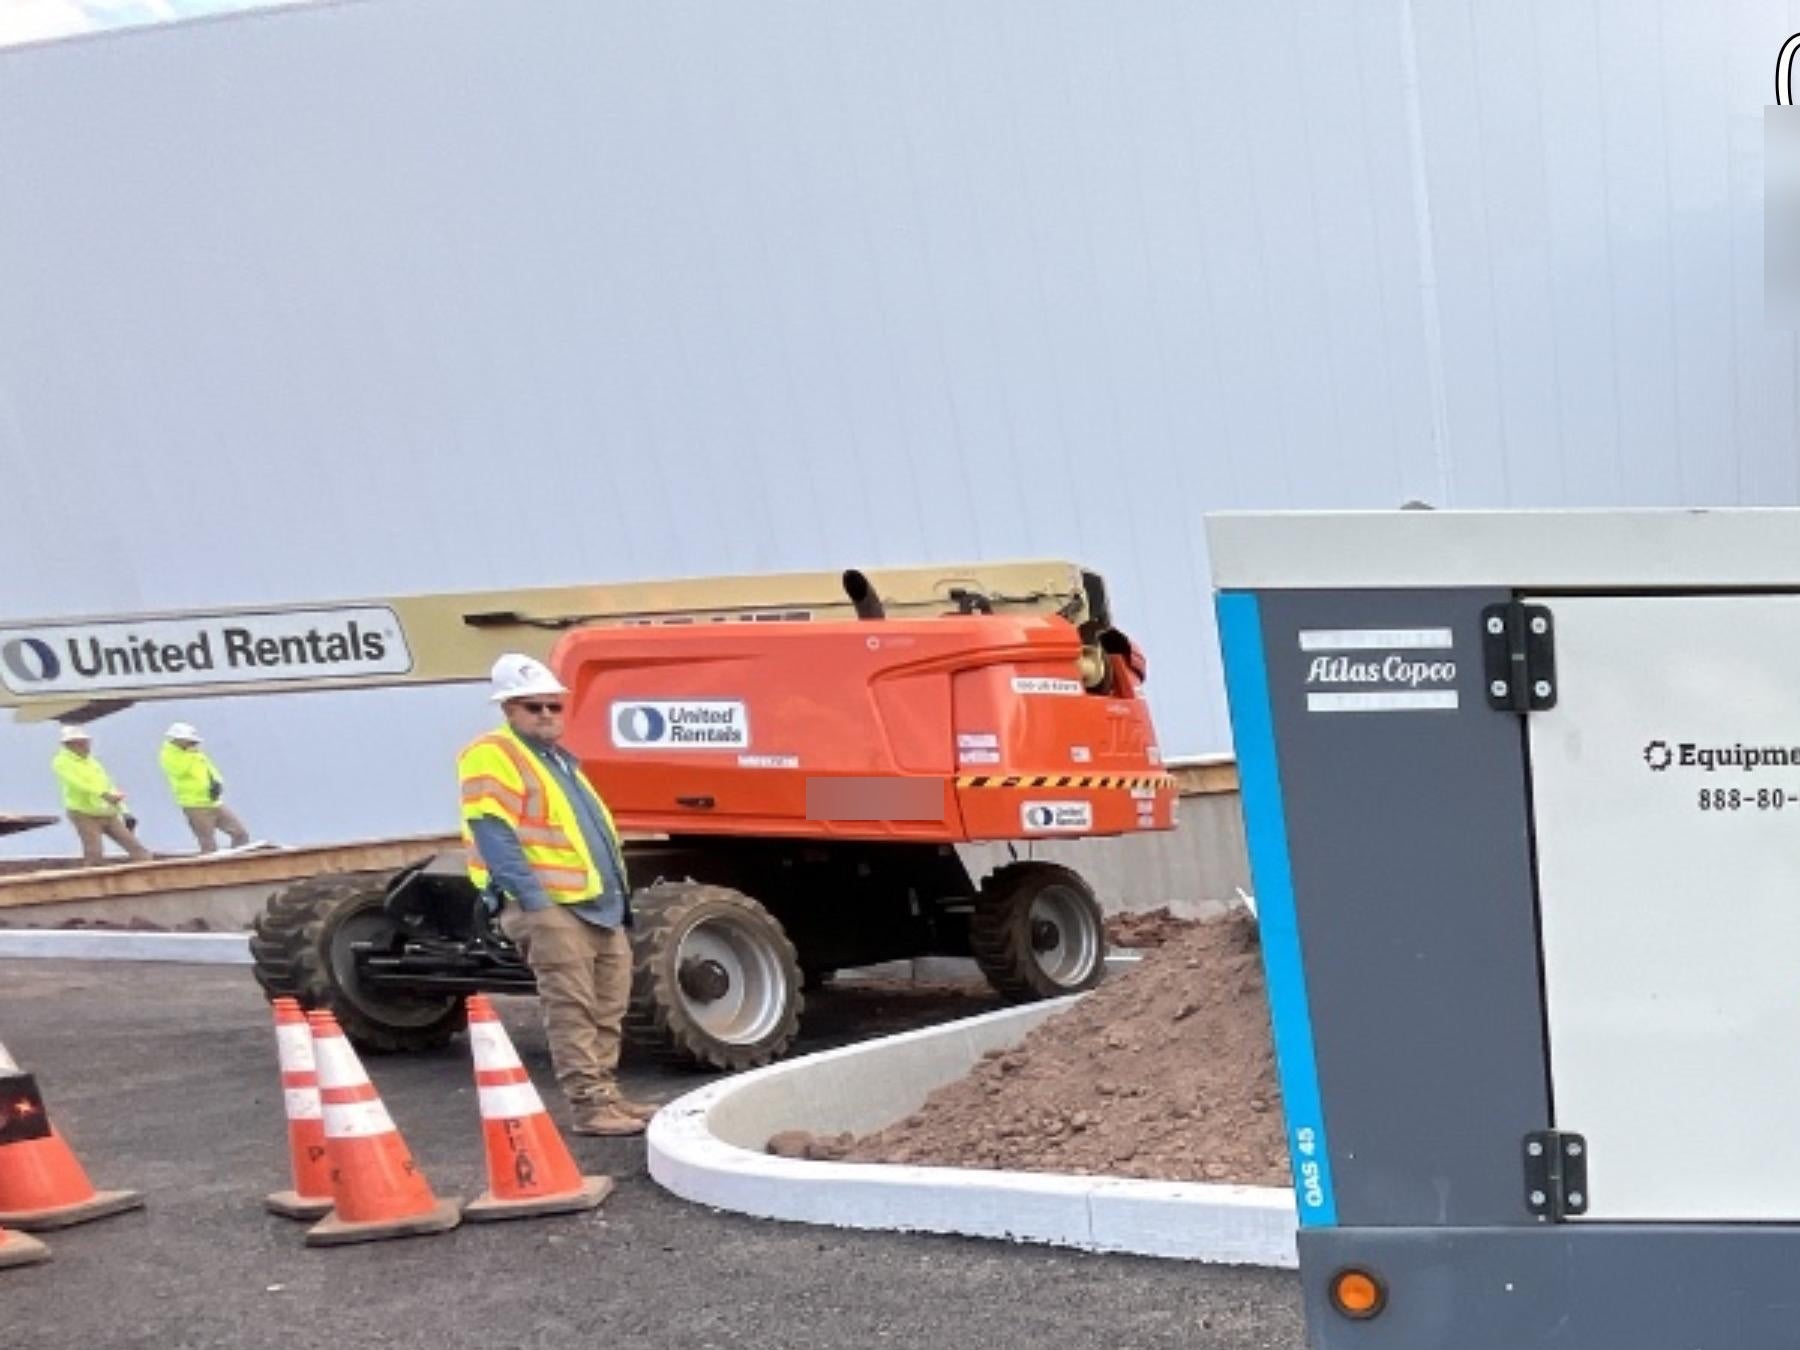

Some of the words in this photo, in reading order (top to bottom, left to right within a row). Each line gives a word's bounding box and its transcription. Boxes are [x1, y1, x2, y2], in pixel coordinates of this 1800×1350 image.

[67, 631, 214, 678] United
[223, 621, 385, 667] Rentals
[1306, 656, 1380, 684] Atlas
[1382, 655, 1456, 688] Copco
[668, 706, 735, 724] United
[671, 725, 742, 742] Rentals
[1297, 1127, 1315, 1157] 45
[1302, 1161, 1324, 1208] QAS
